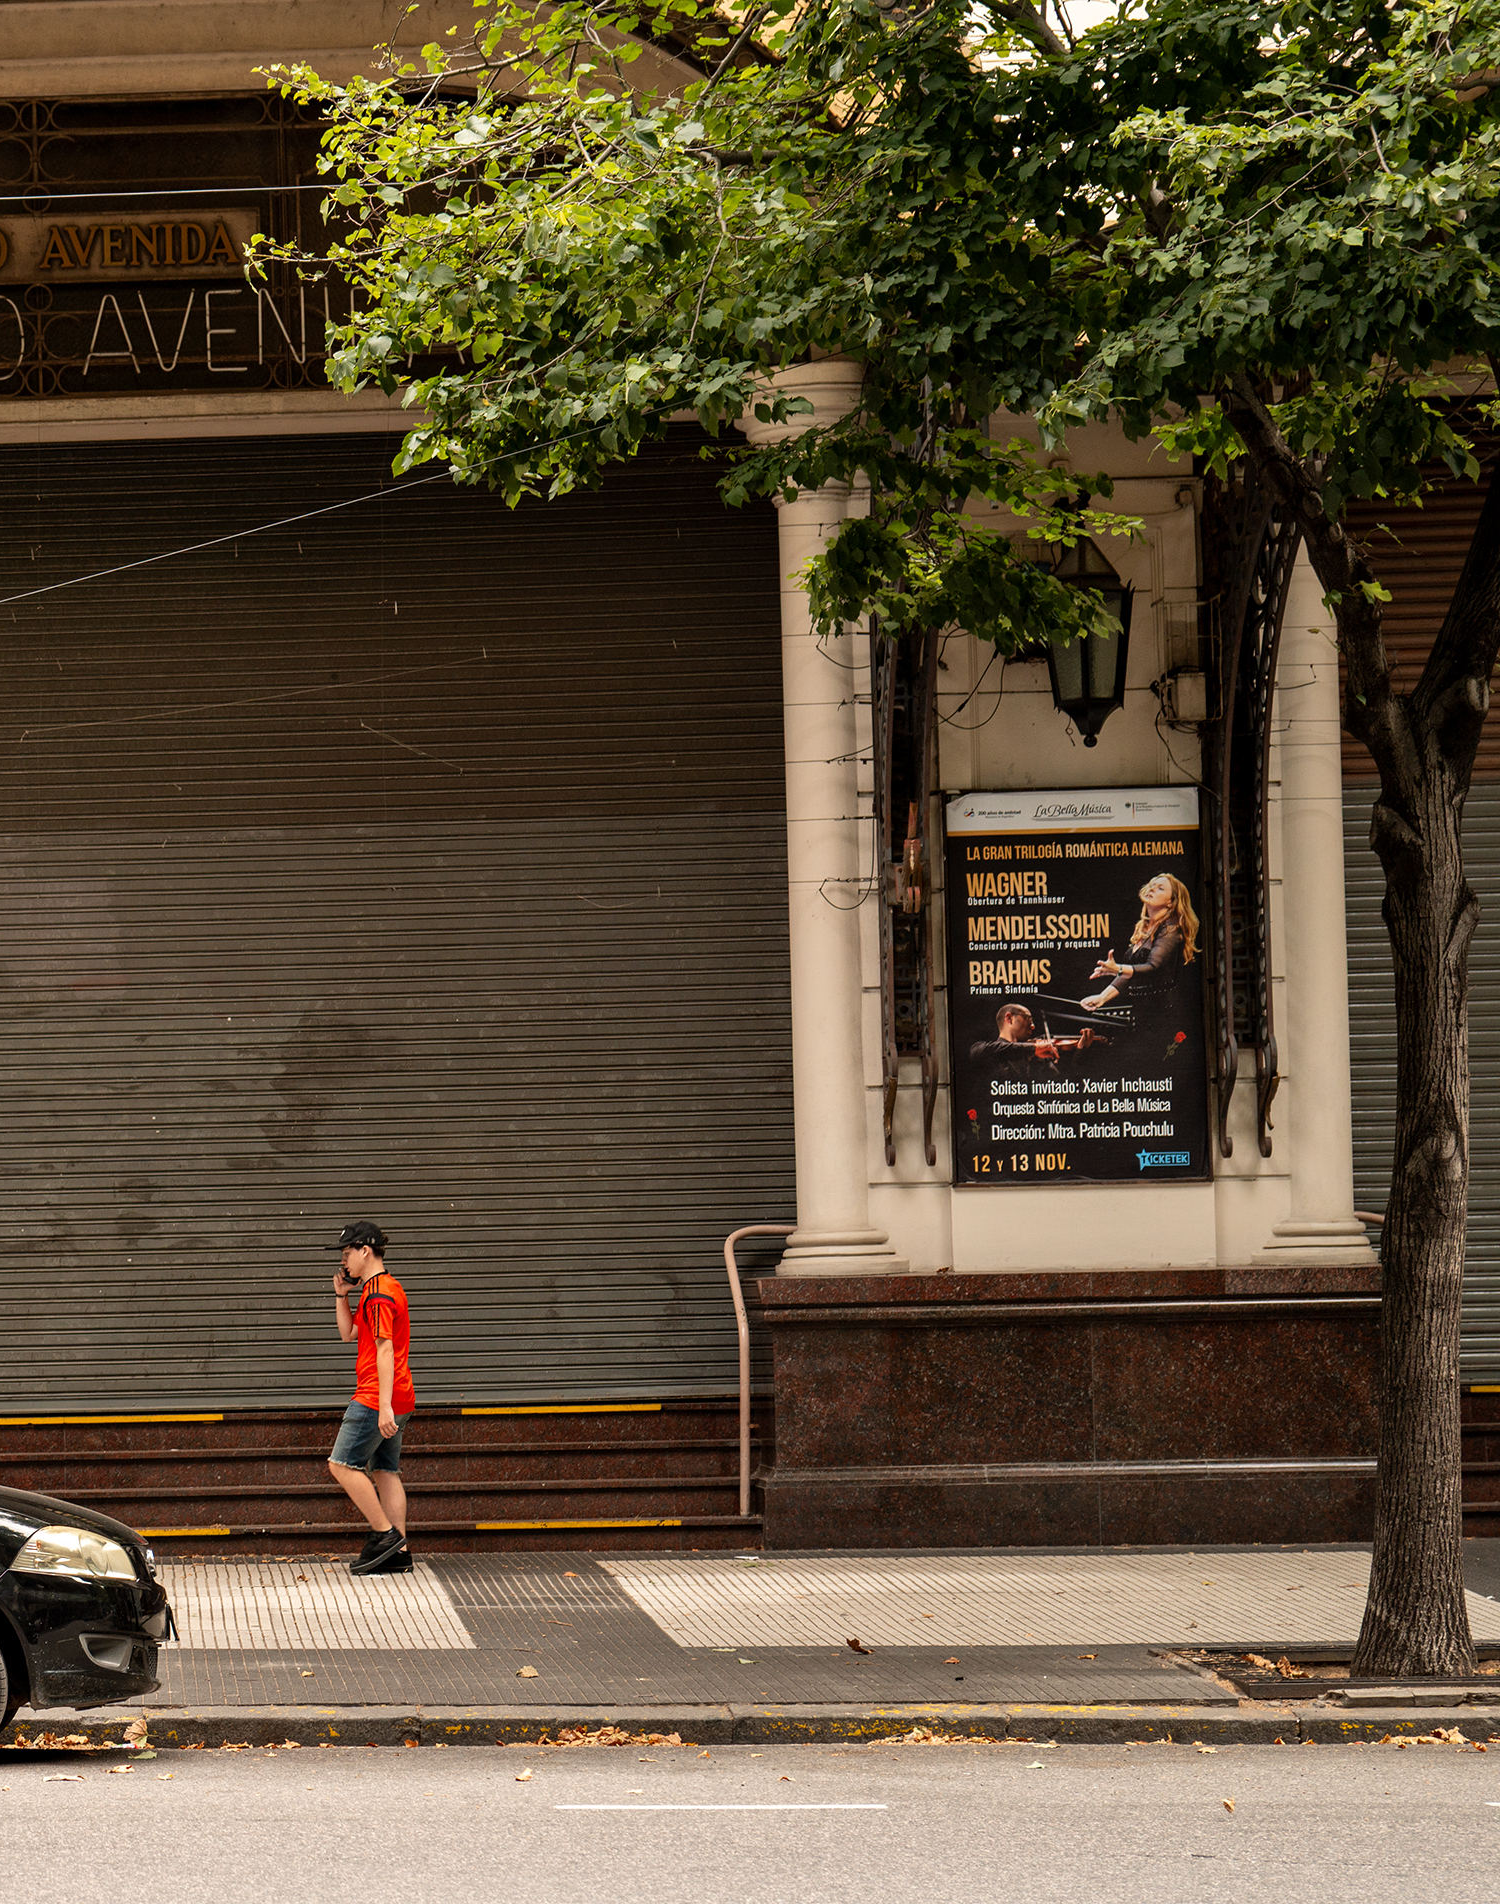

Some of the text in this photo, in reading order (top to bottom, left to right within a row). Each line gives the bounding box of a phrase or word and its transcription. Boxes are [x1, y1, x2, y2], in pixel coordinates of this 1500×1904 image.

[39, 222, 241, 269] AVENIDA
[82, 285, 466, 377] AVENI
[1033, 803, 1112, 818] La Bella Música
[967, 841, 1184, 861] LA GRAN TRILOGÍA ROMÁNTICA ALEMANA
[966, 871, 1048, 898] WAGNER
[967, 895, 1065, 906] Obertura de Tannhäuser
[967, 913, 1110, 941] MENDELSSOHN
[969, 940, 1100, 952] Concierto para violín y orquesta
[969, 959, 1052, 985] BRAHMS
[970, 985, 1039, 995] Primera Sinfonía
[990, 1077, 1173, 1096] Solista invitado: Xavier Inchausti
[993, 1098, 1171, 1118] Orquesta Sinfónica de La Bella Música
[991, 1121, 1174, 1140] Dirección: Mtra. Patricia Pouchulu
[972, 1155, 991, 1172] 12
[1010, 1154, 1029, 1171] 13
[1035, 1153, 1071, 1171] NOV.
[1141, 1154, 1188, 1164] TICKETEK
